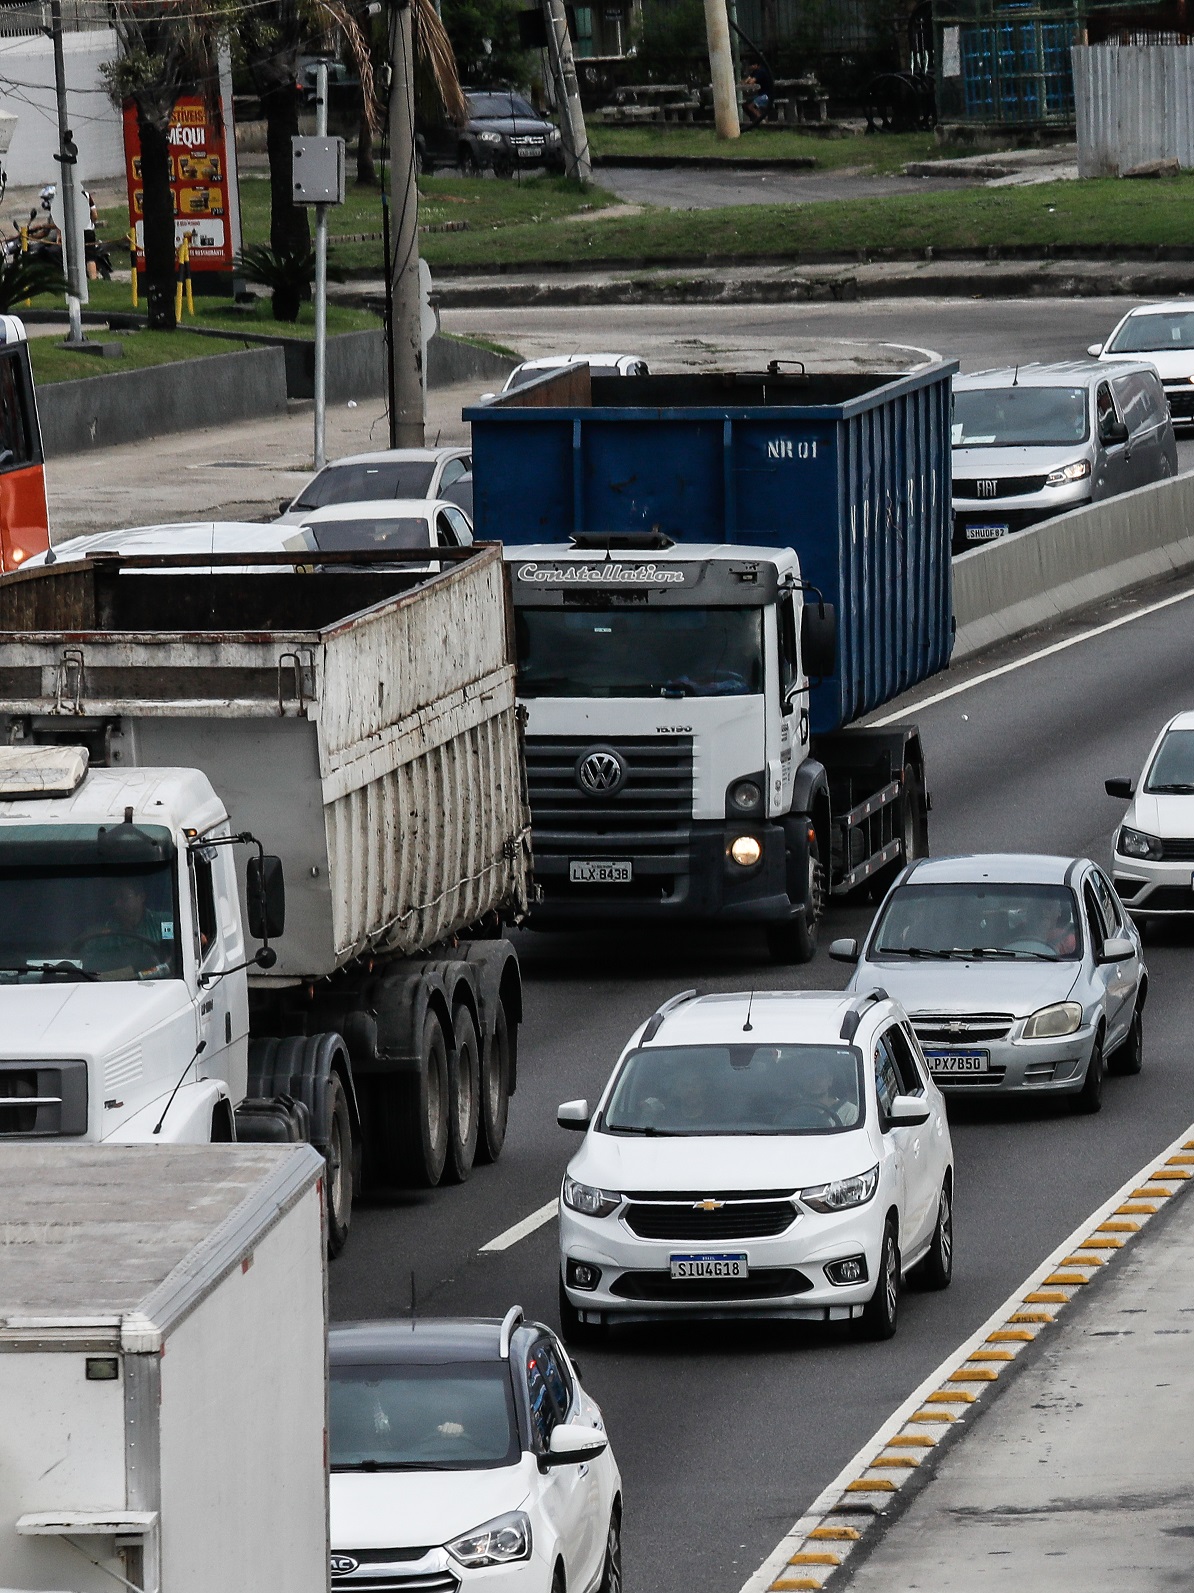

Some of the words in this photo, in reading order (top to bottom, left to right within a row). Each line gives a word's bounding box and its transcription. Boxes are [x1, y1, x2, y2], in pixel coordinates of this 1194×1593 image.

[172, 109, 204, 123] STÍVEIS
[767, 440, 794, 459] NR
[976, 480, 998, 497] FIAT
[517, 563, 685, 583] Constellation
[926, 1057, 981, 1070] LPX7B50
[678, 1262, 740, 1277] SIU4G18
[331, 1559, 351, 1569] AC
